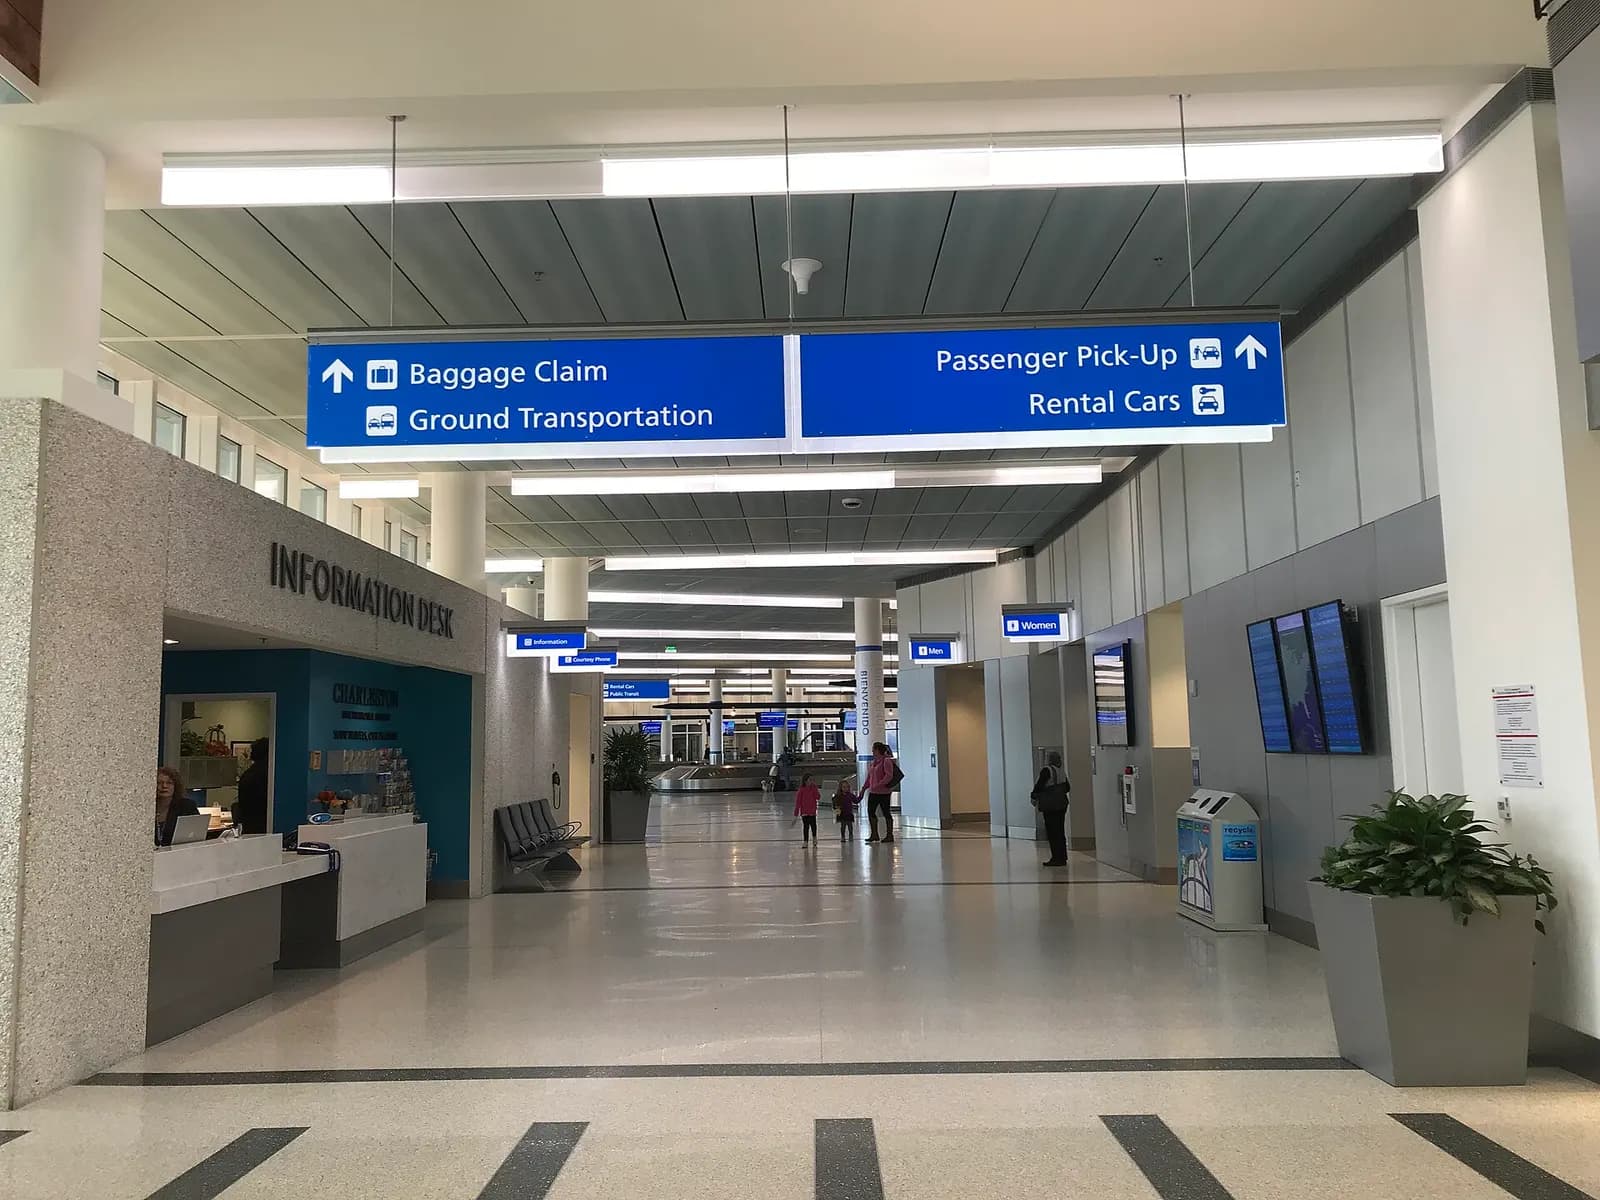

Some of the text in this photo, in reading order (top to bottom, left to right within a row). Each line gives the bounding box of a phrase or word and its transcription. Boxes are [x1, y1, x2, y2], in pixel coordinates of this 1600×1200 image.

[936, 343, 1178, 375] Passenger Pick-Up
[410, 359, 608, 389] Baggage Claim
[409, 404, 713, 432] Ground Transportation
[1030, 391, 1181, 416] Rental Cars
[270, 542, 454, 639] INFORMATION DESK
[1021, 620, 1057, 630] Women
[928, 647, 944, 655] Men
[860, 670, 870, 736] BIENVENIDO
